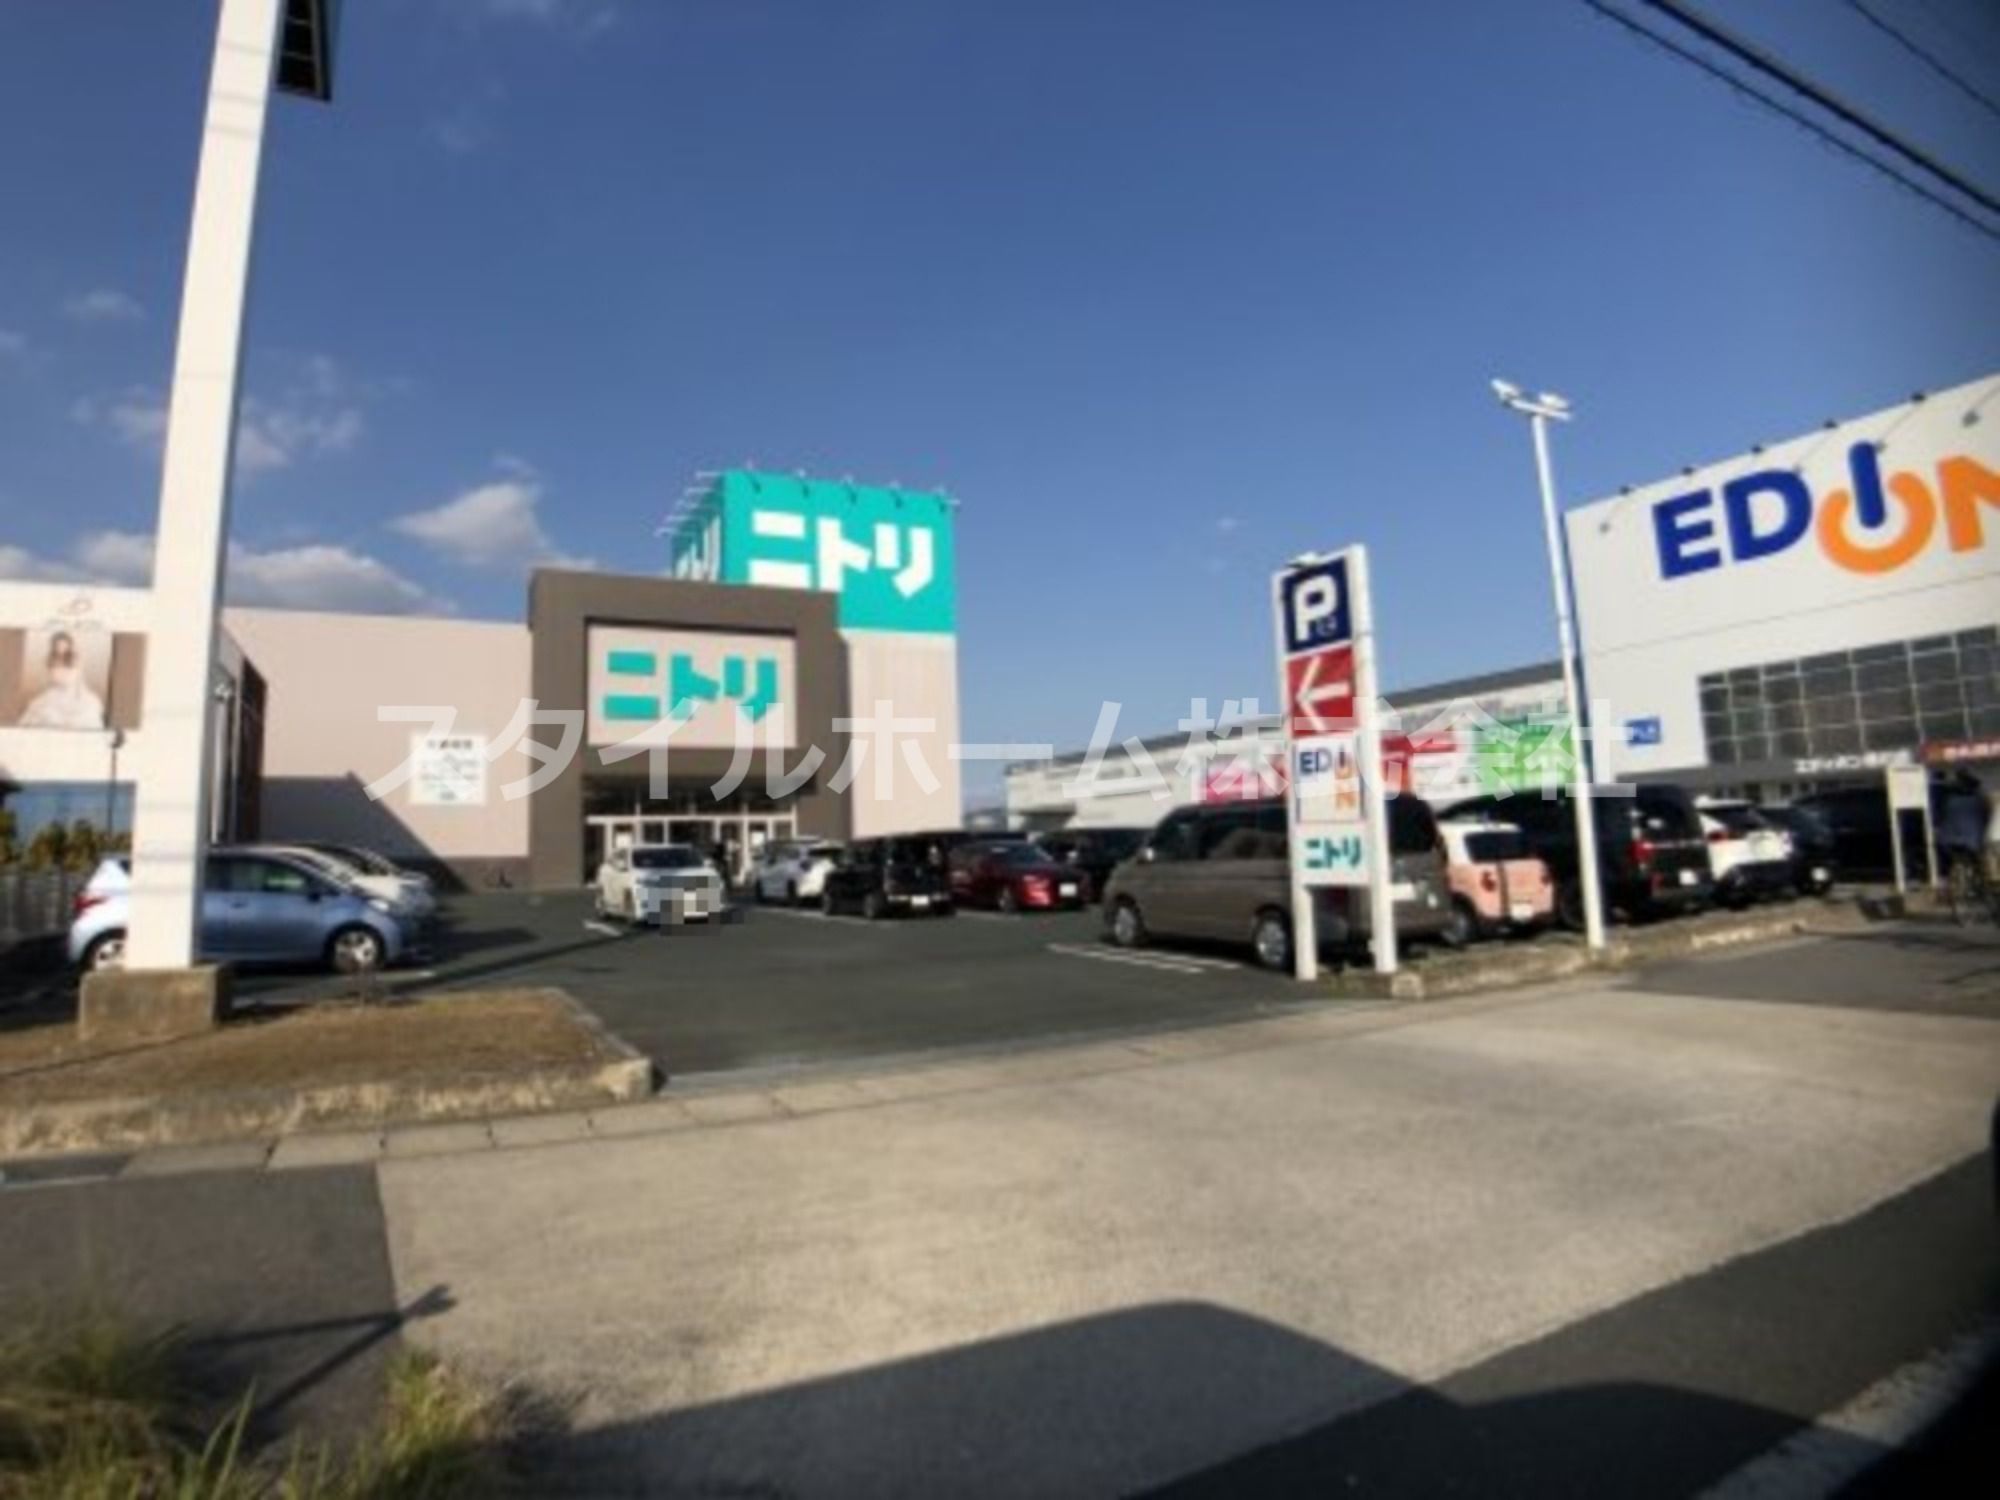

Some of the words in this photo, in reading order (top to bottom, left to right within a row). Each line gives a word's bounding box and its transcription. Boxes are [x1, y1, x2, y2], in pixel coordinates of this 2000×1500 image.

[748, 510, 933, 598] ニトリ
[1295, 575, 1337, 641] P
[605, 651, 778, 723] ニトリ
[1306, 837, 1361, 869] ニトリ
